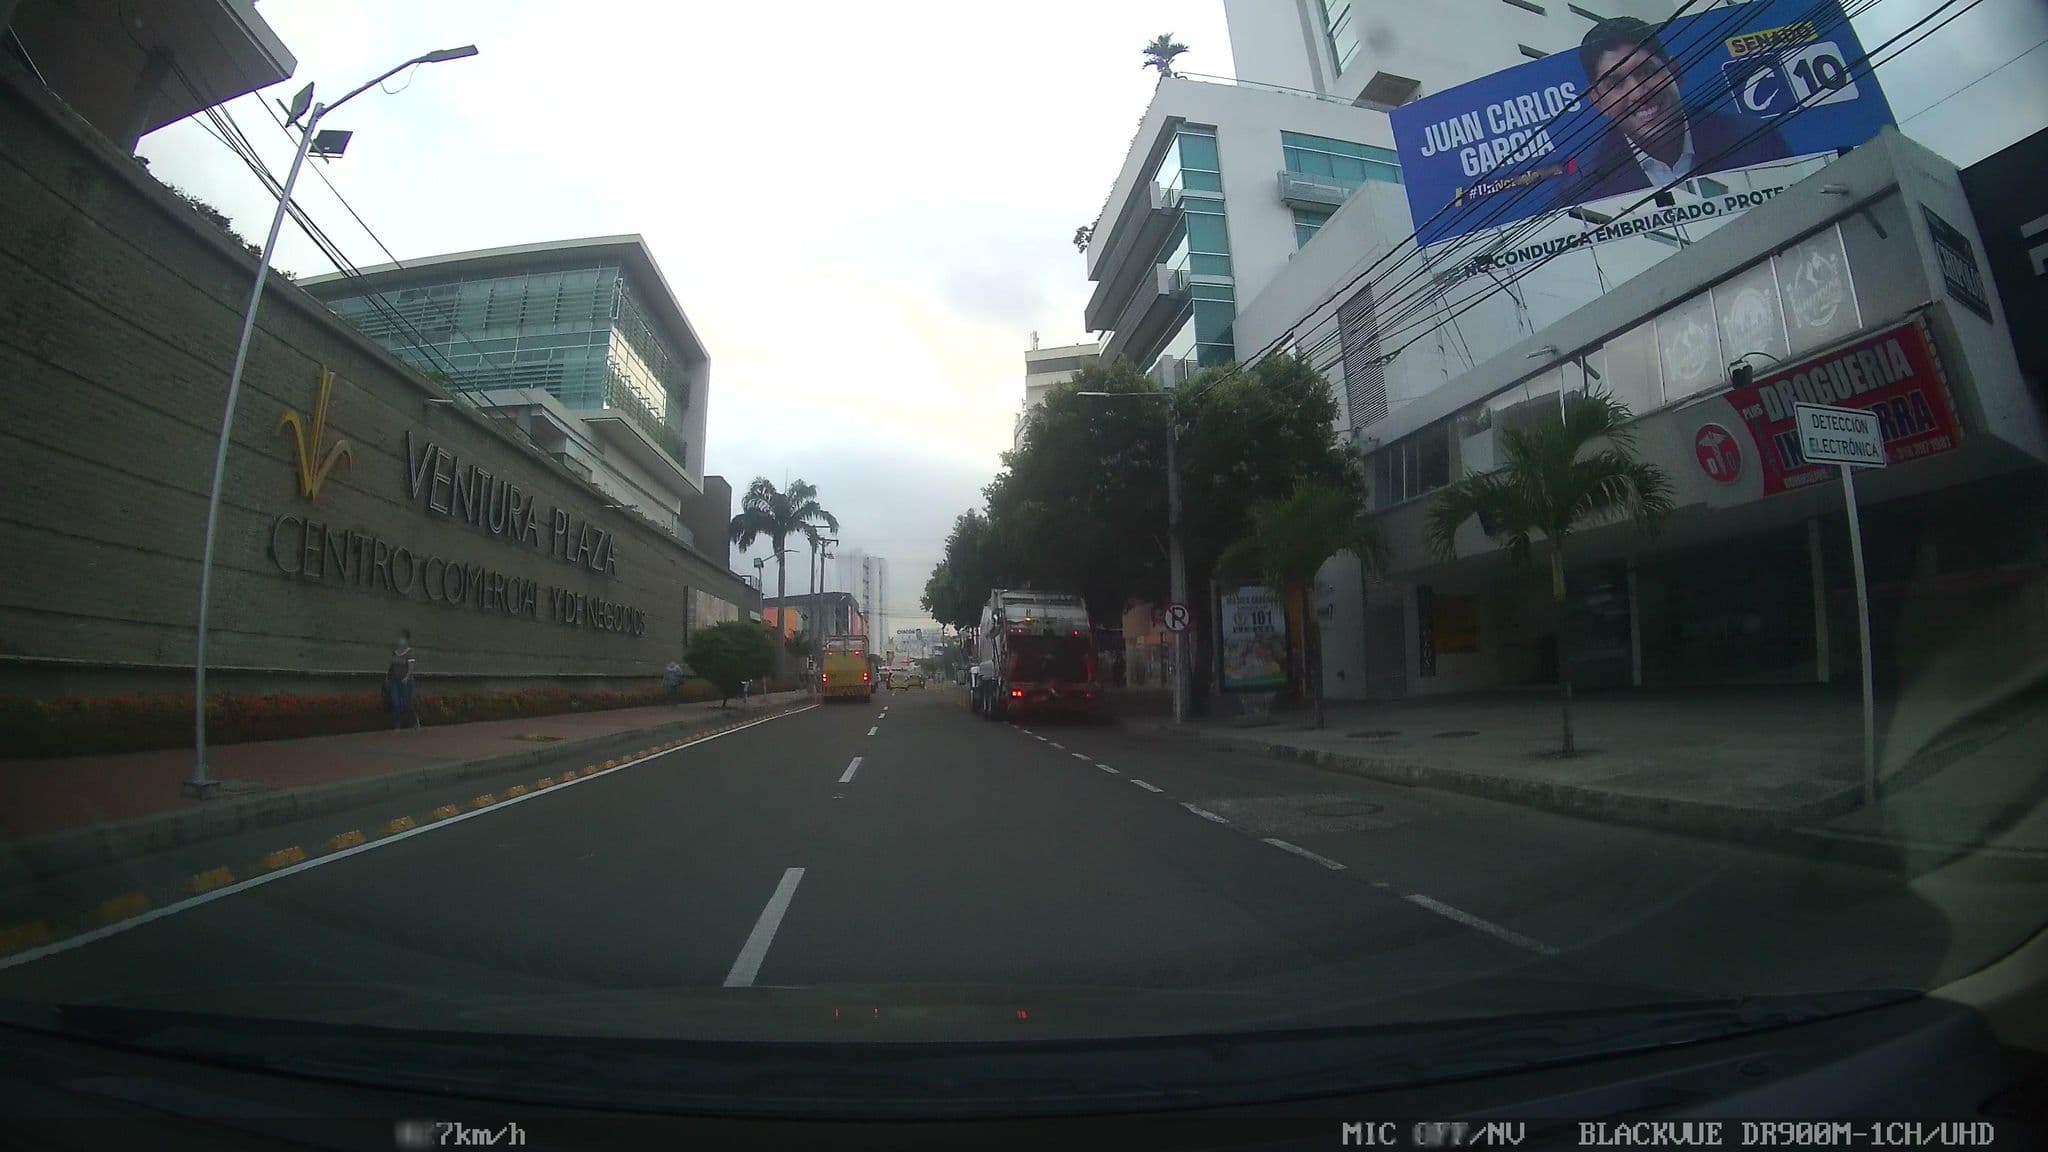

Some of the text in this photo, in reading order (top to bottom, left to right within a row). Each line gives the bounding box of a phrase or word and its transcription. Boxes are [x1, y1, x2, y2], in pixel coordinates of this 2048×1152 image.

[1793, 55, 1846, 96] 10
[1421, 82, 1581, 156] JUAN CARLOS
[1494, 231, 1592, 269] CONDUZCA
[1597, 201, 1723, 243] EMBRIAGADO,
[1759, 338, 1914, 423] DROGUERIA
[407, 430, 617, 576] VENTURA PLAZA
[272, 512, 415, 594] CENTRO
[424, 556, 538, 618] COMERCIAL
